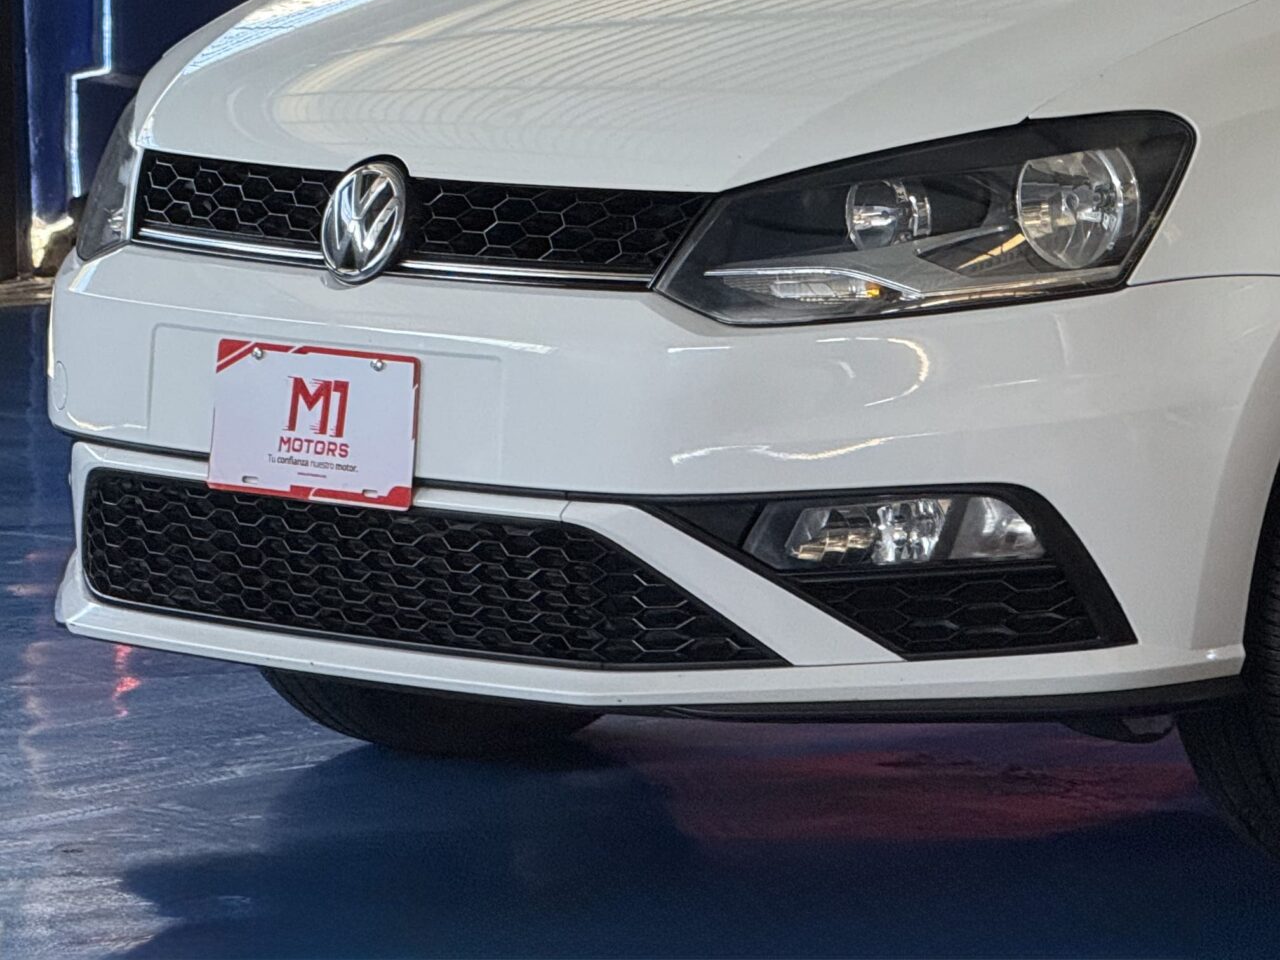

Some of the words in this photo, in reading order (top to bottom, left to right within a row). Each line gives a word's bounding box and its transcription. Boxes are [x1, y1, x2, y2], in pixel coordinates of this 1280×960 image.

[282, 375, 349, 438] M1
[278, 436, 350, 458] MOTORS
[268, 453, 276, 463] Tu
[277, 455, 309, 467] confianza
[310, 460, 335, 470] nuestro
